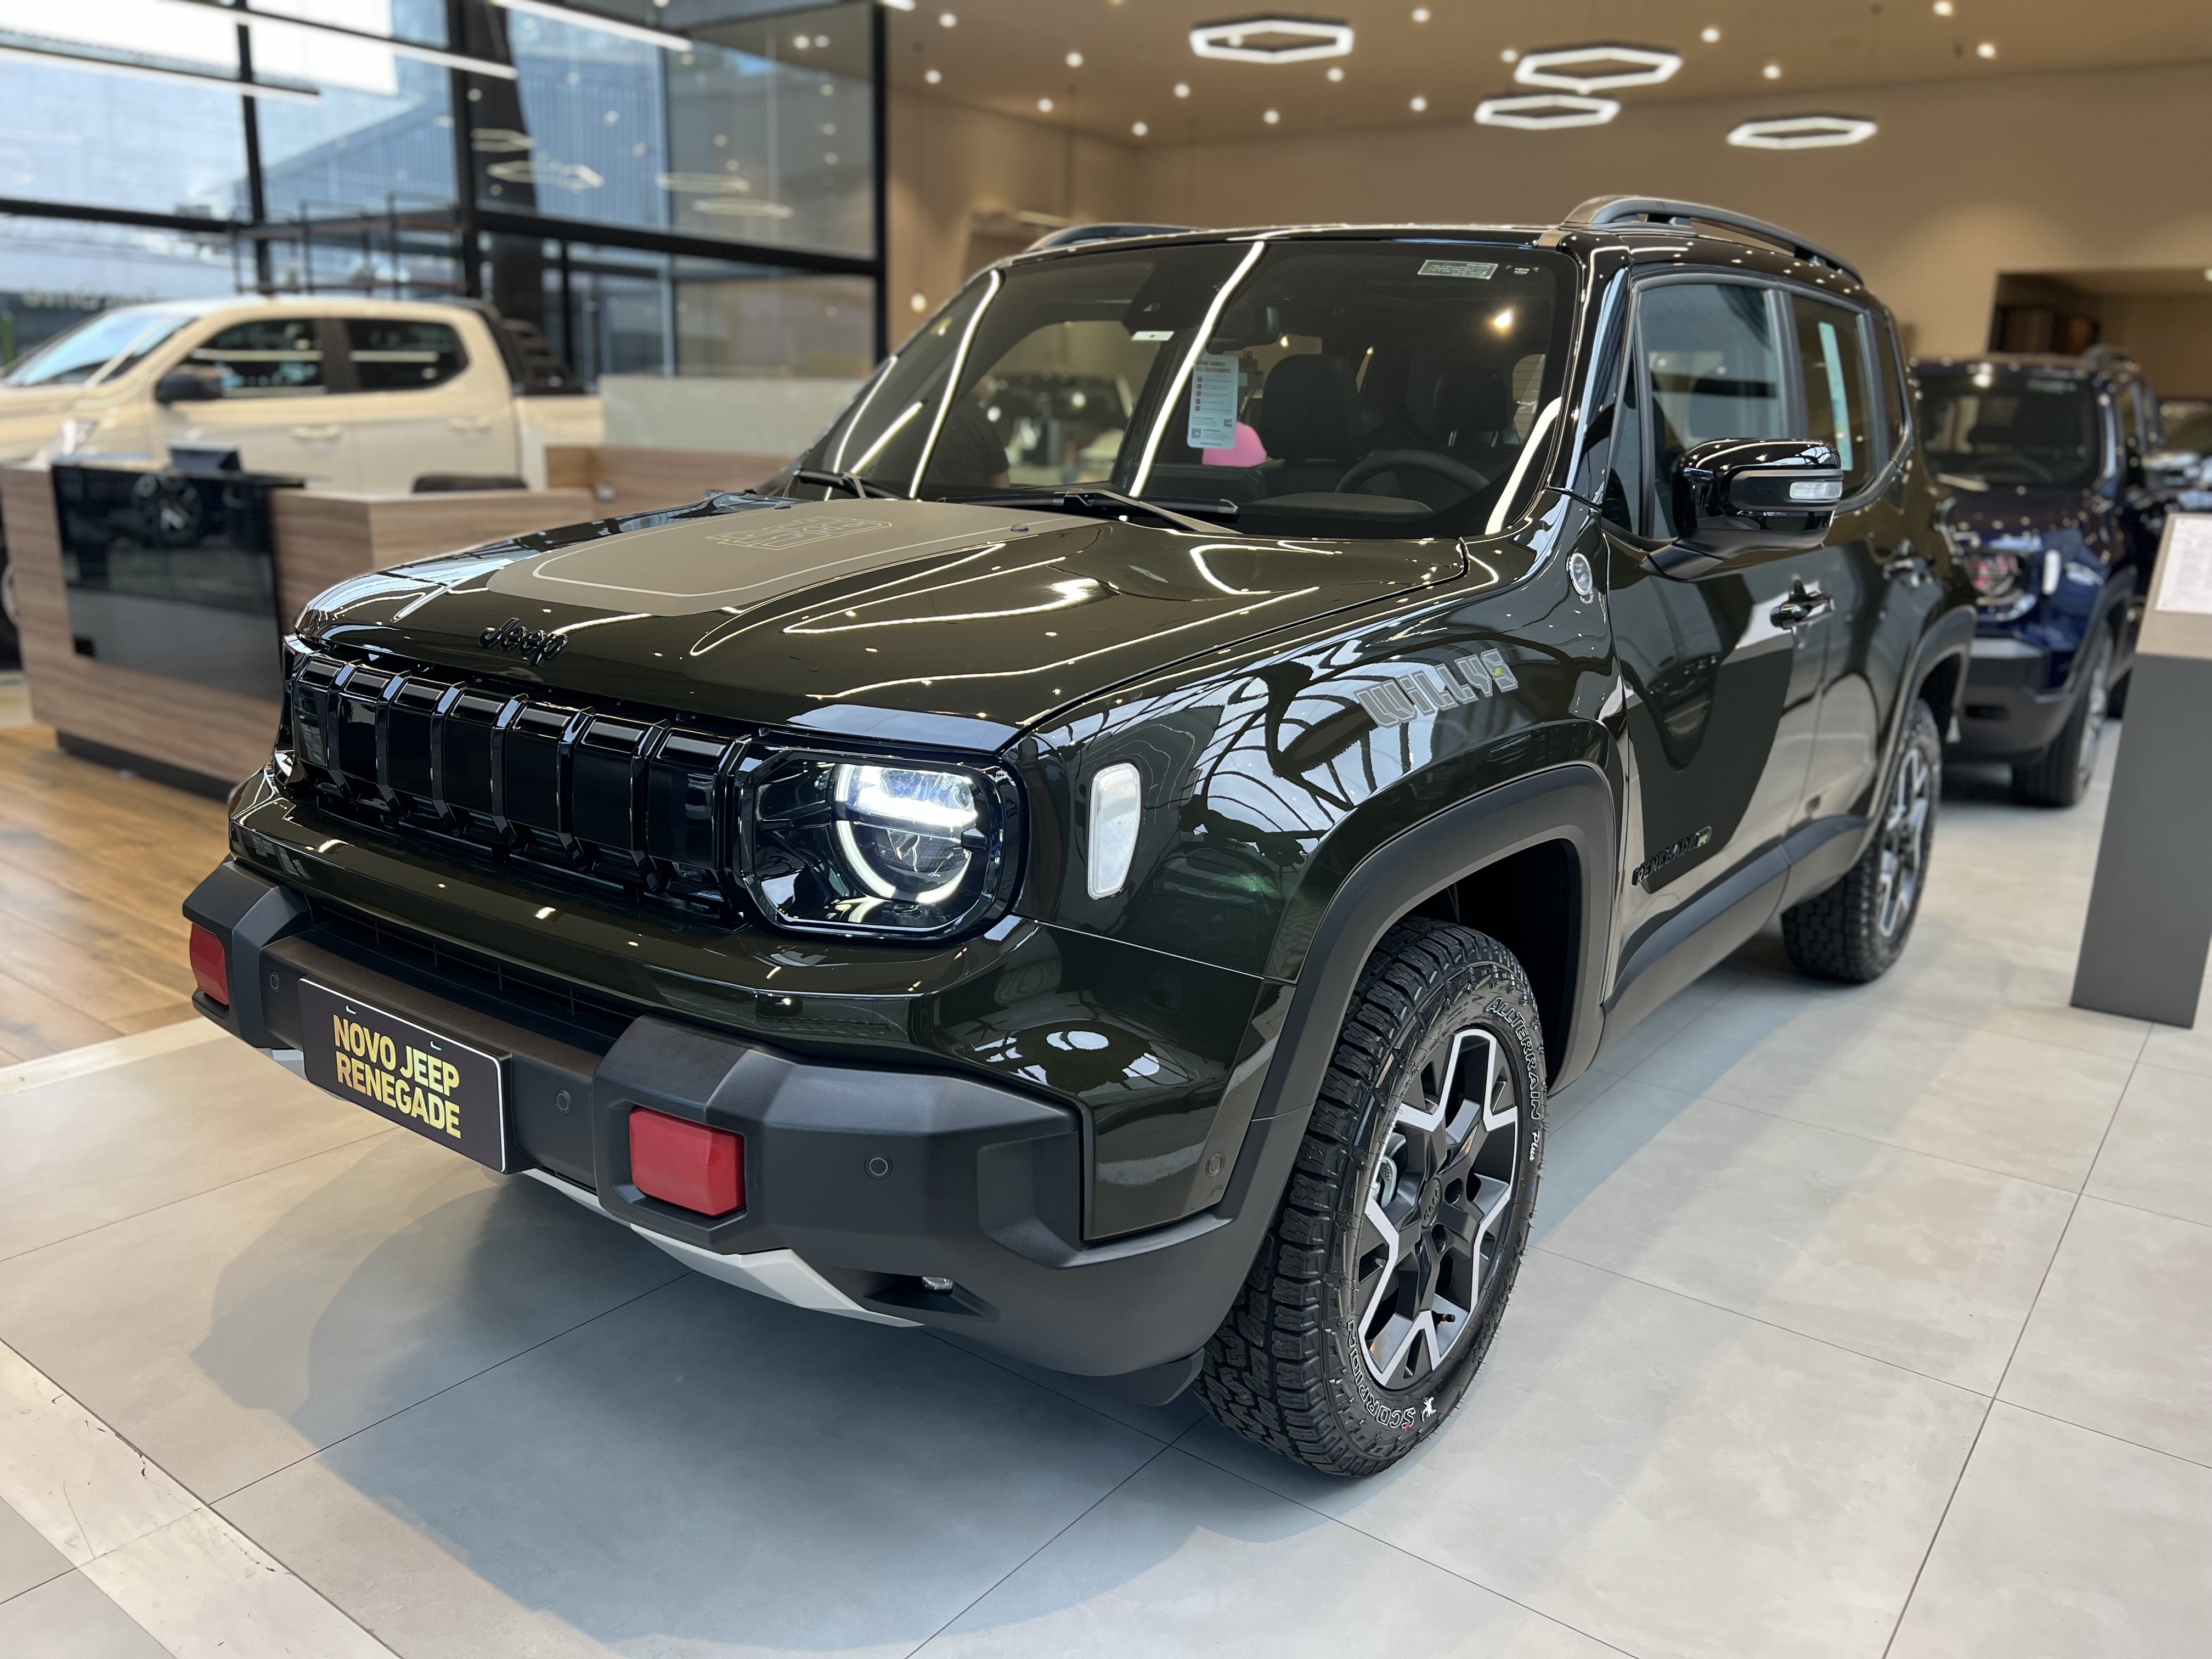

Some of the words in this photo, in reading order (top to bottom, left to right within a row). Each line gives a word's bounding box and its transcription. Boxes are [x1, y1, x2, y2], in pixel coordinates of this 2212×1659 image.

[478, 617, 568, 666] Jeep
[1632, 834, 1697, 885] RENEGADE
[333, 1014, 396, 1071] NOVO
[399, 1046, 460, 1097] JEEP
[335, 1051, 461, 1139] RENEGADE
[1347, 1319, 1416, 1430] SCORPION
